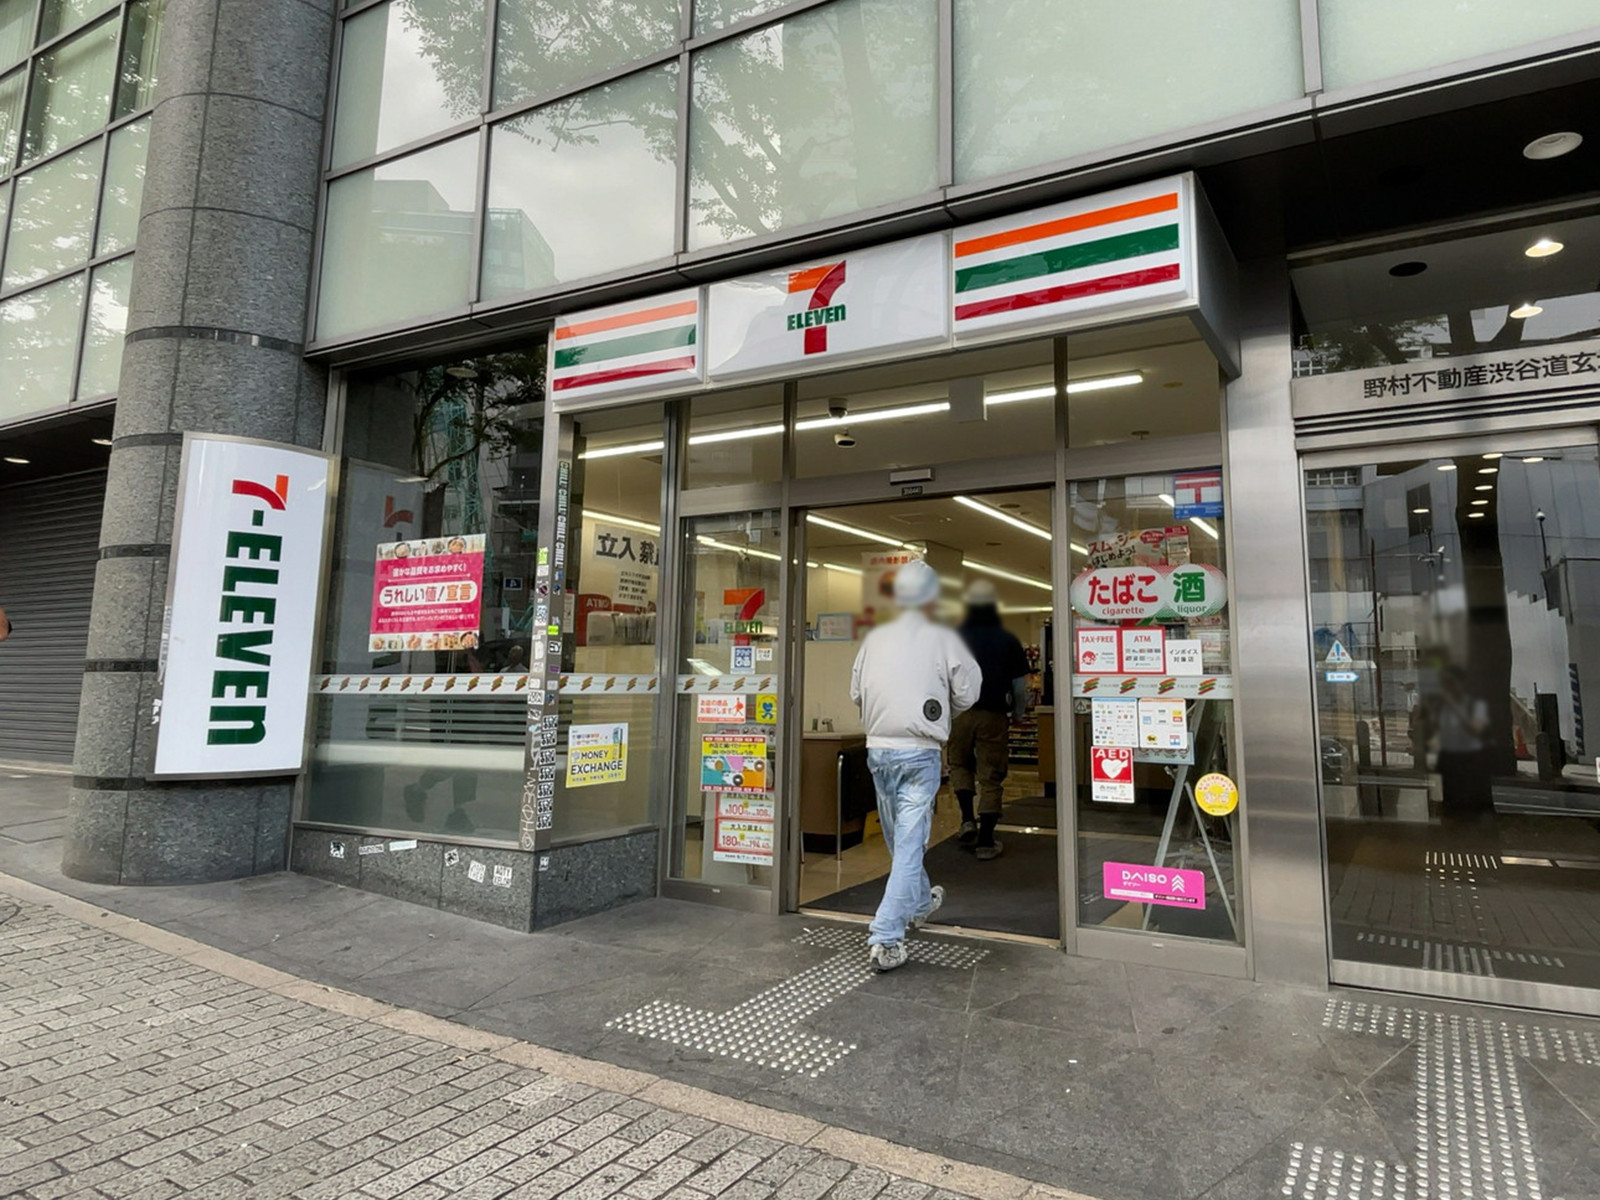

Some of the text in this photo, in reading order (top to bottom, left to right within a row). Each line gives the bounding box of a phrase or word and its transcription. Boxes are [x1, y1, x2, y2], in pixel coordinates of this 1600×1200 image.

[788, 260, 846, 355] 7
[1363, 351, 1600, 399] 野村不動産渋谷道玄
[1088, 572, 1205, 605] たばこ 酒
[1102, 604, 1207, 616] cigarette liquor
[1081, 635, 1151, 644] TAX-FREE ATM
[581, 750, 609, 760] MONEY
[1095, 748, 1129, 759] AED
[571, 760, 623, 775] EXCHANGE
[1122, 870, 1168, 884] DAISO
